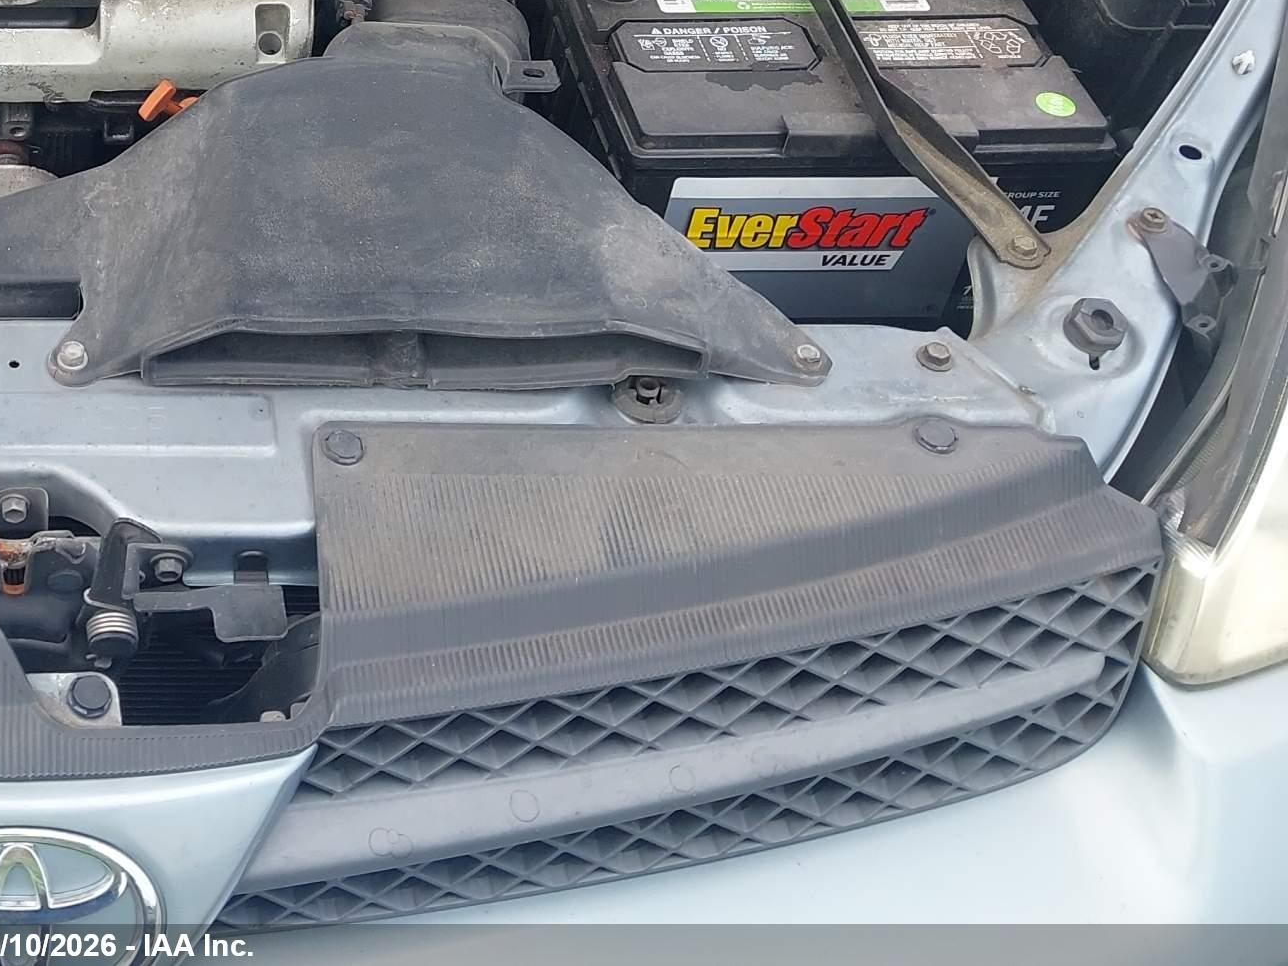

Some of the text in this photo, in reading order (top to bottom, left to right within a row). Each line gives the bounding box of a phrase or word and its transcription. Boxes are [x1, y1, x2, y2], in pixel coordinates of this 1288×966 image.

[662, 27, 712, 35] DANGER
[723, 26, 768, 34] POISON
[1006, 191, 1037, 200] ROUP
[686, 205, 929, 250] EverStart
[821, 253, 891, 267] VALUE
